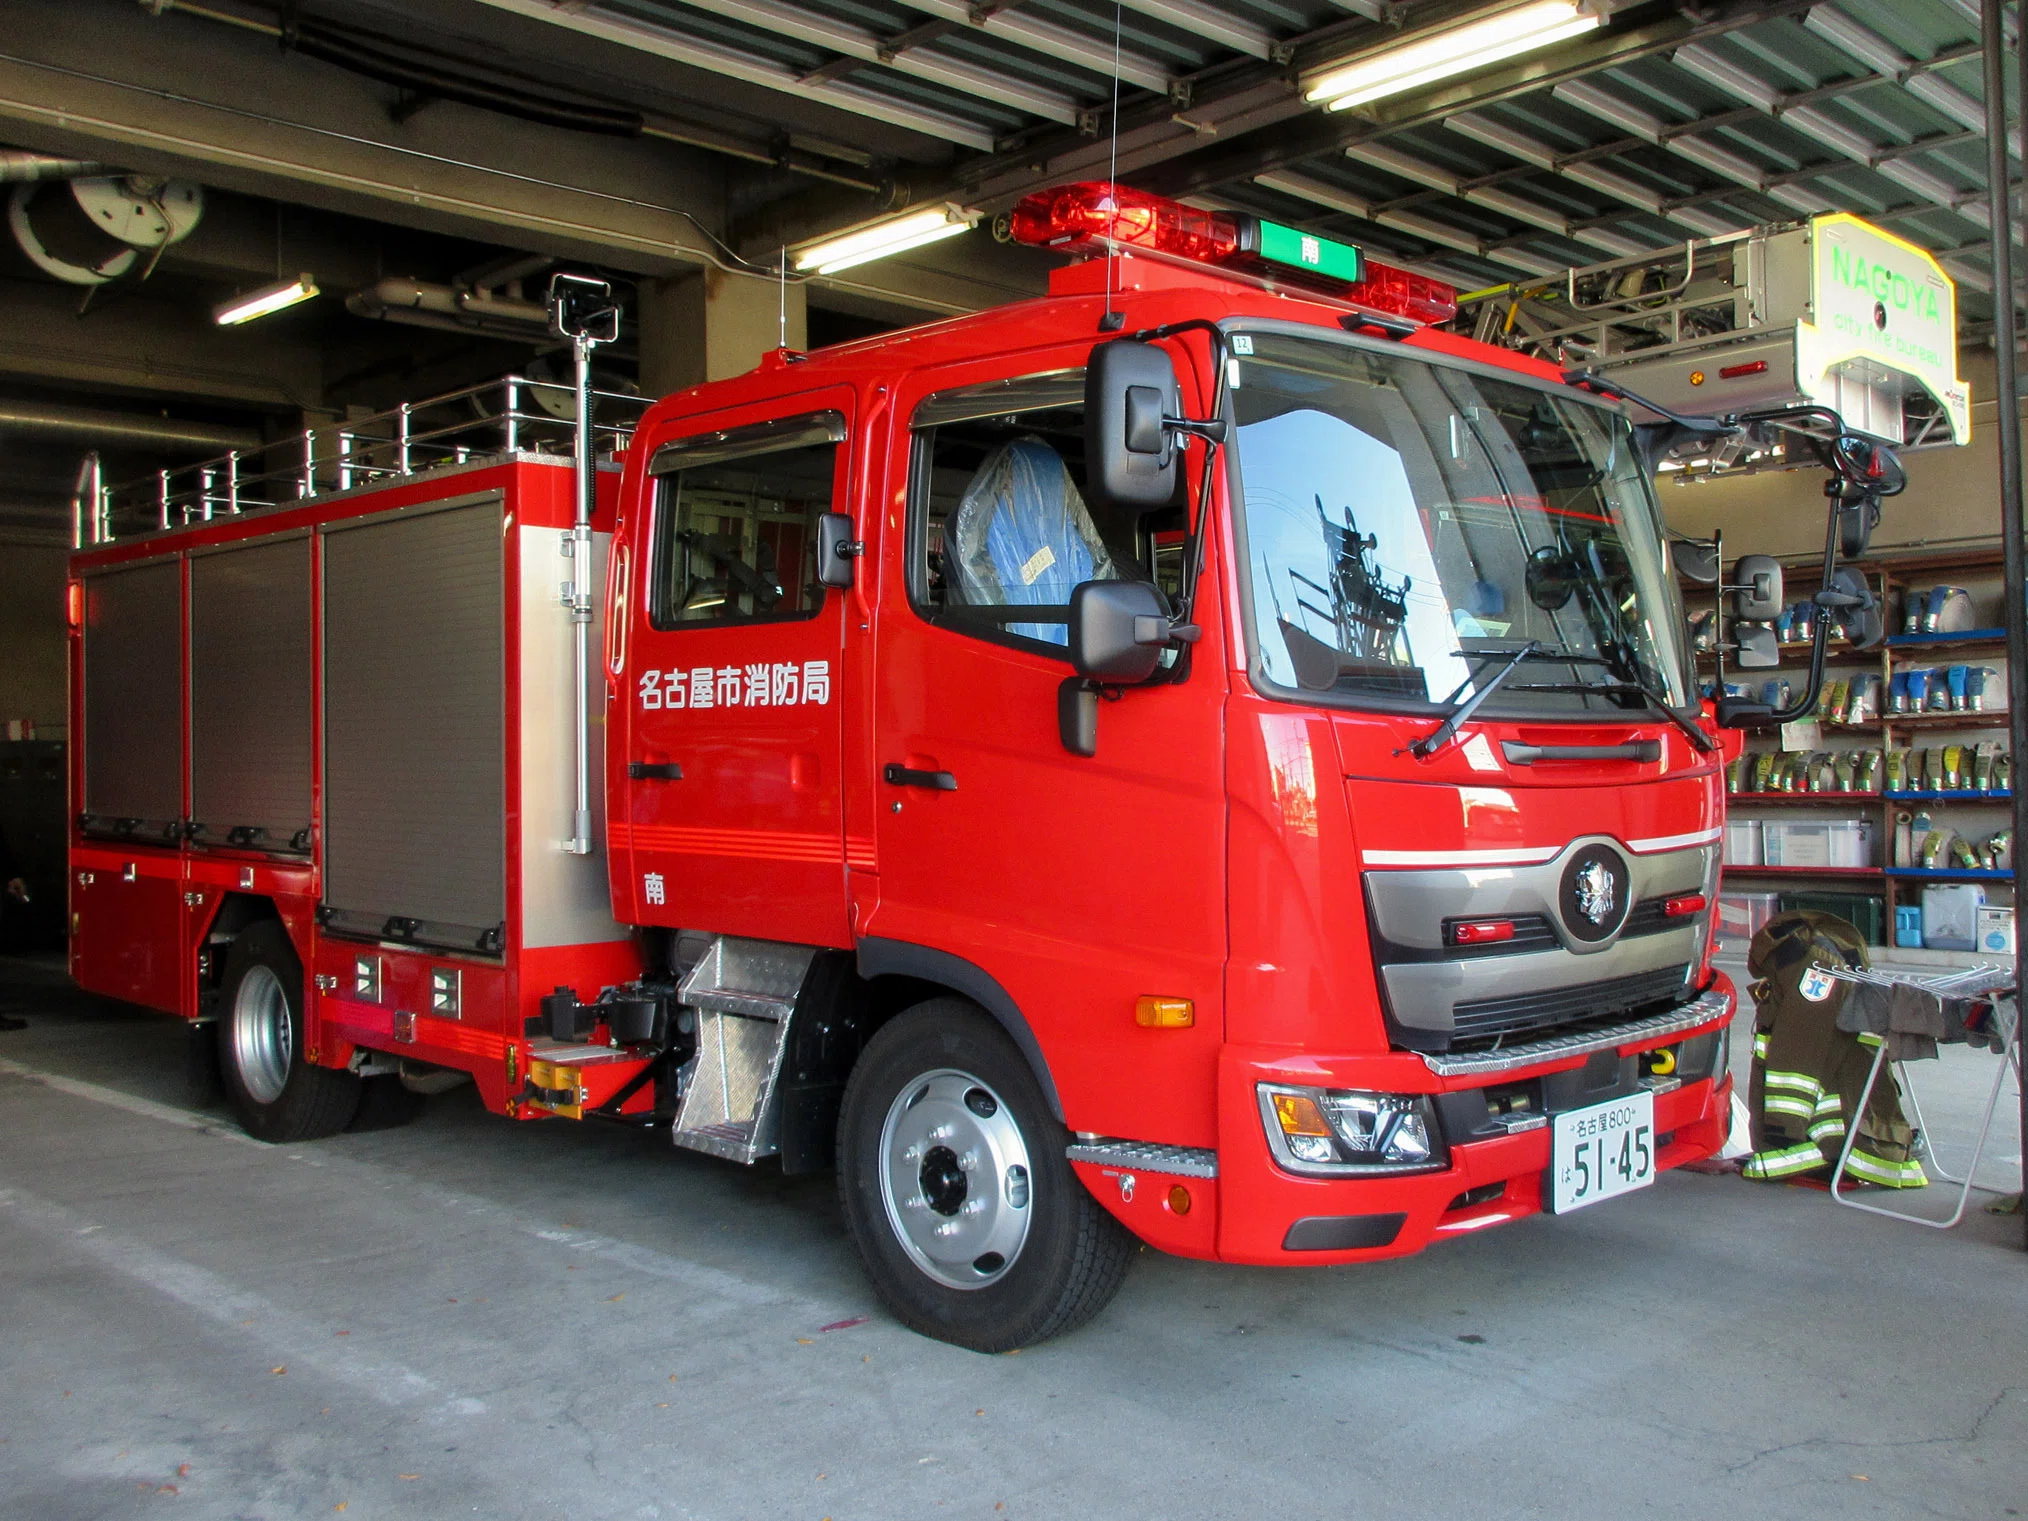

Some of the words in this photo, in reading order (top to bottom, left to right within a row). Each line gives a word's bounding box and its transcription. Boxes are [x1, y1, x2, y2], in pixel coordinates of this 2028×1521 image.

[1301, 236, 1319, 265] 南
[1832, 245, 1940, 326] NAGOYA
[1896, 336, 1943, 368] bureau
[639, 661, 830, 710] 名古屋市消防局
[644, 871, 666, 905] 南
[1561, 1165, 1572, 1184] は
[1574, 1125, 1649, 1198] 51-45
